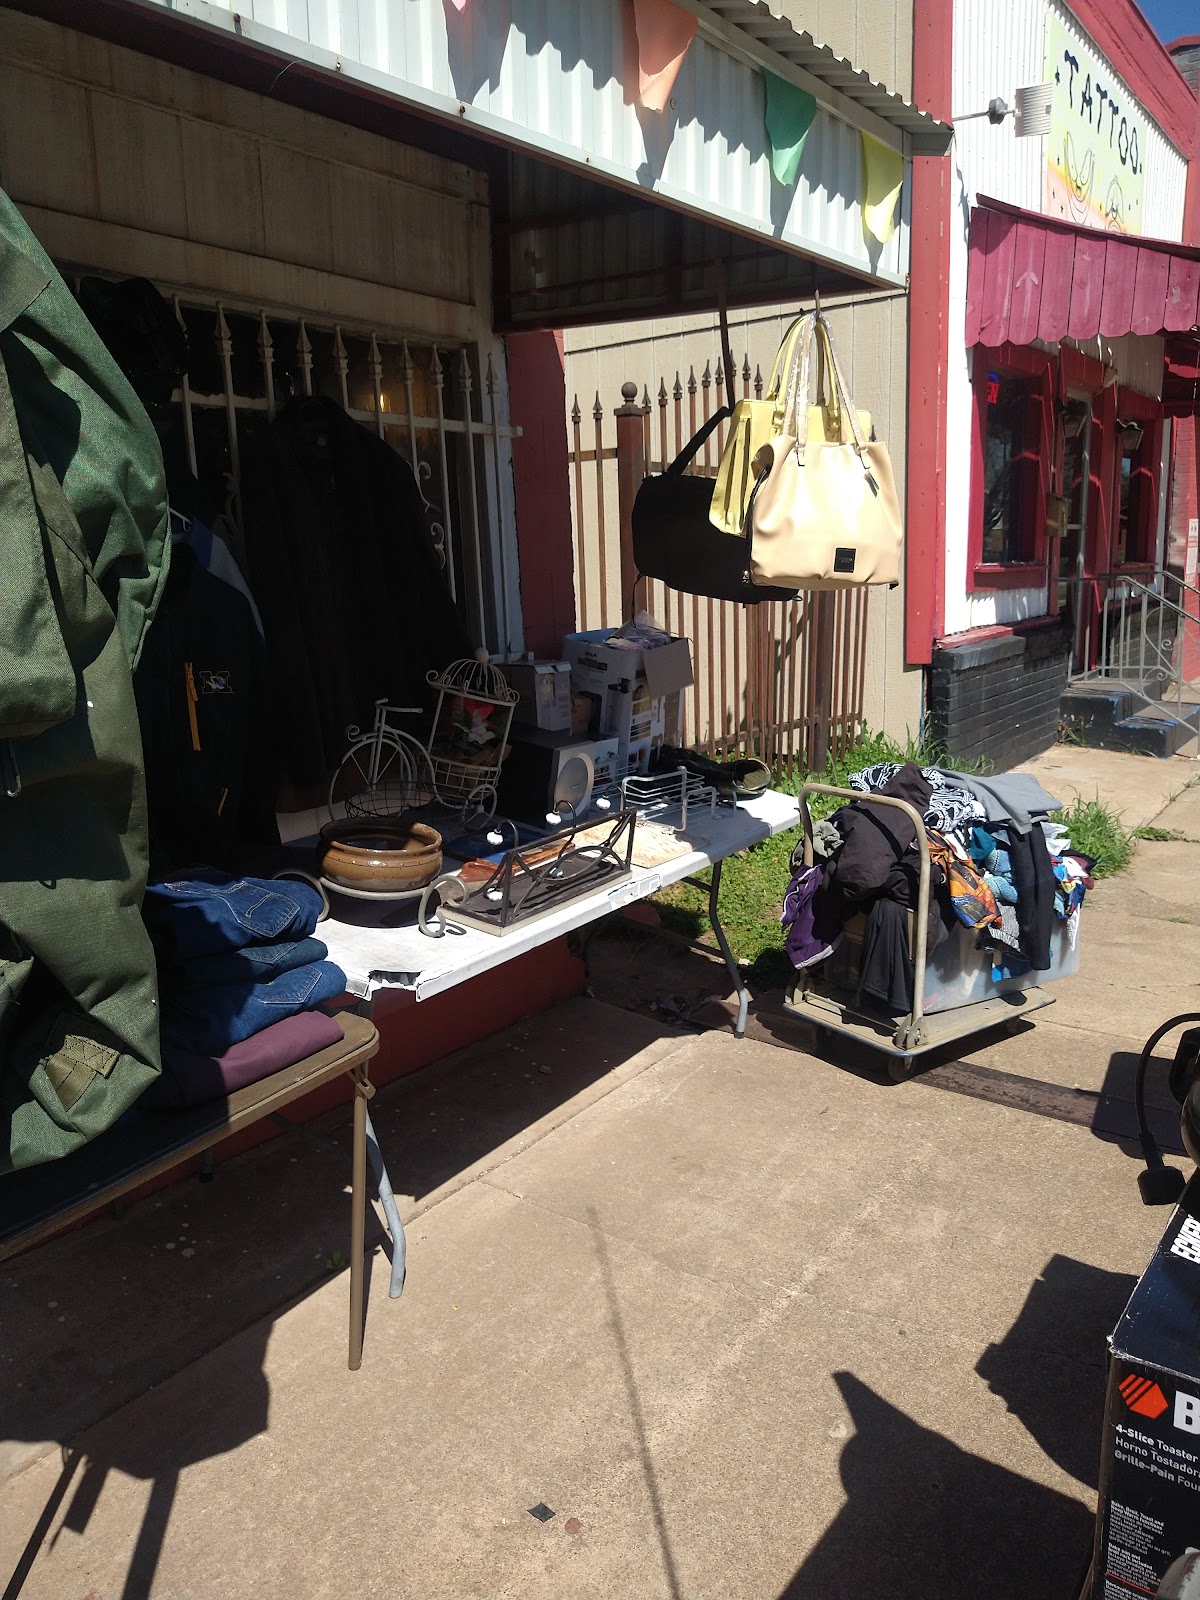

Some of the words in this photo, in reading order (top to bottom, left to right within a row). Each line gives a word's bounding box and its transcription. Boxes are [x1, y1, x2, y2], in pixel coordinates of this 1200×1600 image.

[1115, 1423, 1154, 1446] 4-Slice
[1156, 1439, 1198, 1462] Toaster
[1115, 1436, 1148, 1457] Horno
[1150, 1449, 1200, 1479] Tostador
[1114, 1449, 1175, 1482] Grille-Pain
